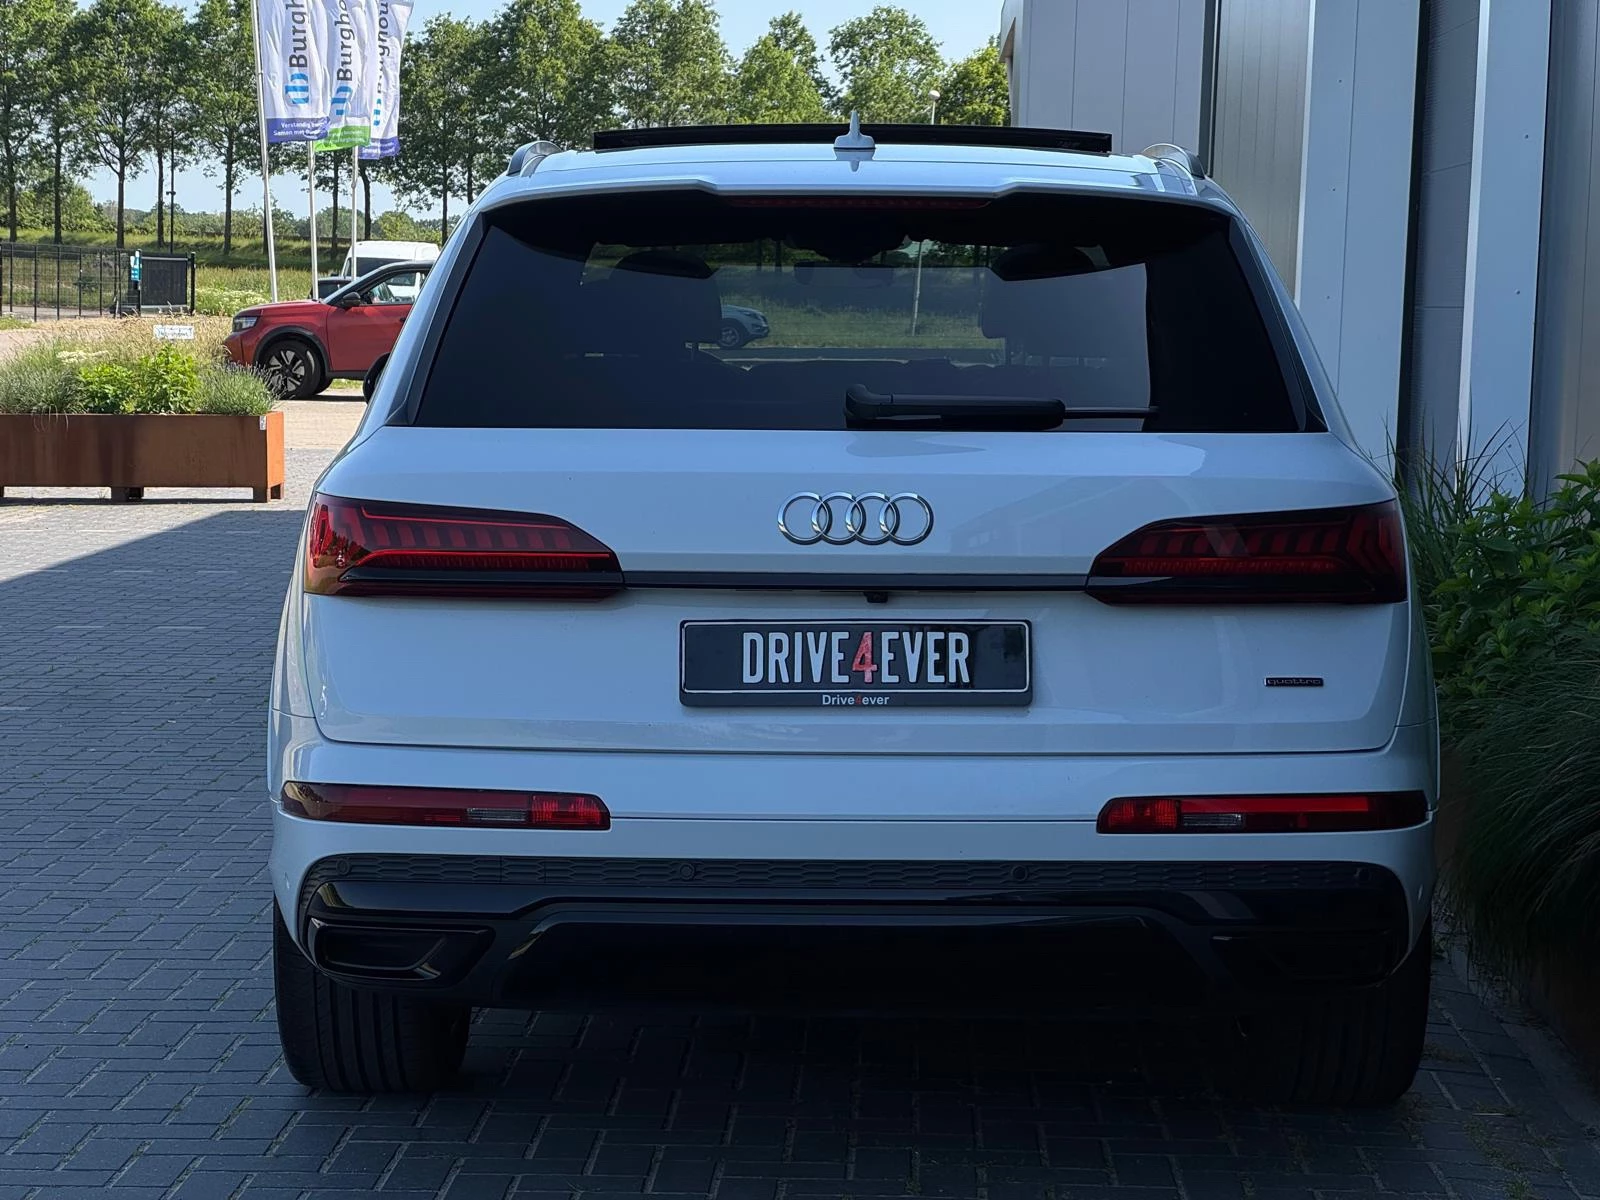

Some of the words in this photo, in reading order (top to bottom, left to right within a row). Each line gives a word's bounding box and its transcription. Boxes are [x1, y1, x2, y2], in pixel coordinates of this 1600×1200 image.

[742, 631, 970, 684] DRIVE4EVER
[1266, 678, 1322, 686] quattro
[822, 694, 890, 705] Drive4ever
